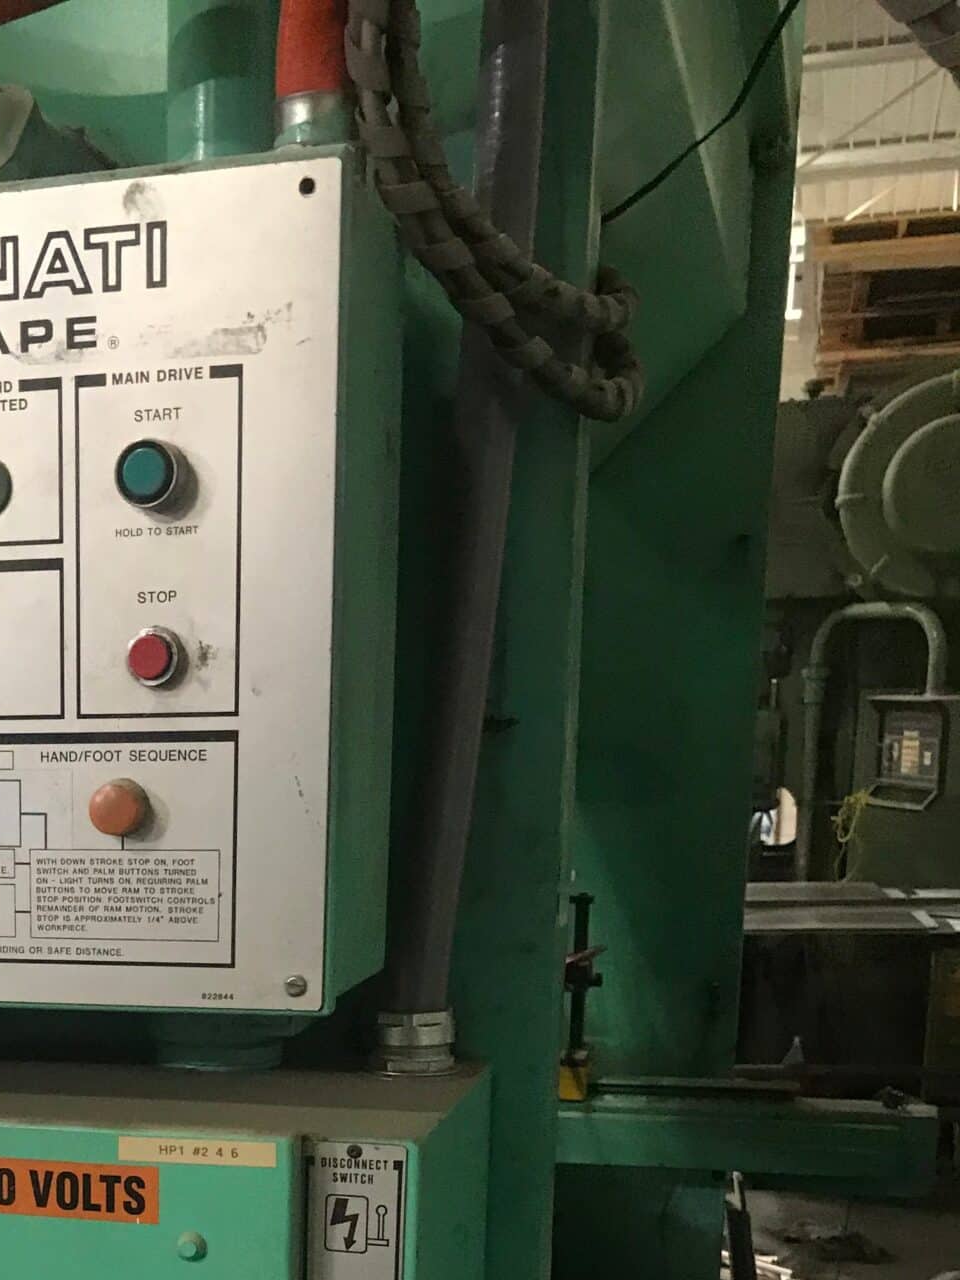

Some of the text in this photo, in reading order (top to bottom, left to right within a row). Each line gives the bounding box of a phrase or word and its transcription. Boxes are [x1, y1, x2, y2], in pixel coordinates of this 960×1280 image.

[112, 367, 204, 386] MAIN DRIVE
[134, 407, 182, 422] START
[115, 526, 199, 538] HOLD TO START
[137, 590, 178, 604] STOP
[40, 750, 208, 763] HAND/FOOT SEQUENCE
[59, 858, 85, 866] DOWN
[89, 858, 123, 866] STROKE
[127, 858, 150, 866] STOP
[171, 858, 194, 866] FOOT
[36, 867, 68, 875] SWITCH
[71, 867, 89, 875] AND
[118, 868, 159, 876] BUTTONS
[163, 868, 196, 876] TURNED
[59, 877, 82, 885] LIGHT
[87, 877, 114, 885] TURNS
[135, 877, 182, 885] REQUIRING
[35, 886, 75, 894] BUTTONS
[159, 887, 194, 895] STROKE
[36, 895, 215, 905] STOP FOOTSWITCH CONTROLS
[36, 905, 84, 913] REMAINDER
[158, 1144, 239, 1158] HP1 #2 4 6
[321, 1156, 388, 1171] DISCONNECT
[332, 1172, 375, 1185] SWITCH
[28, 1170, 146, 1216] VOLTS
